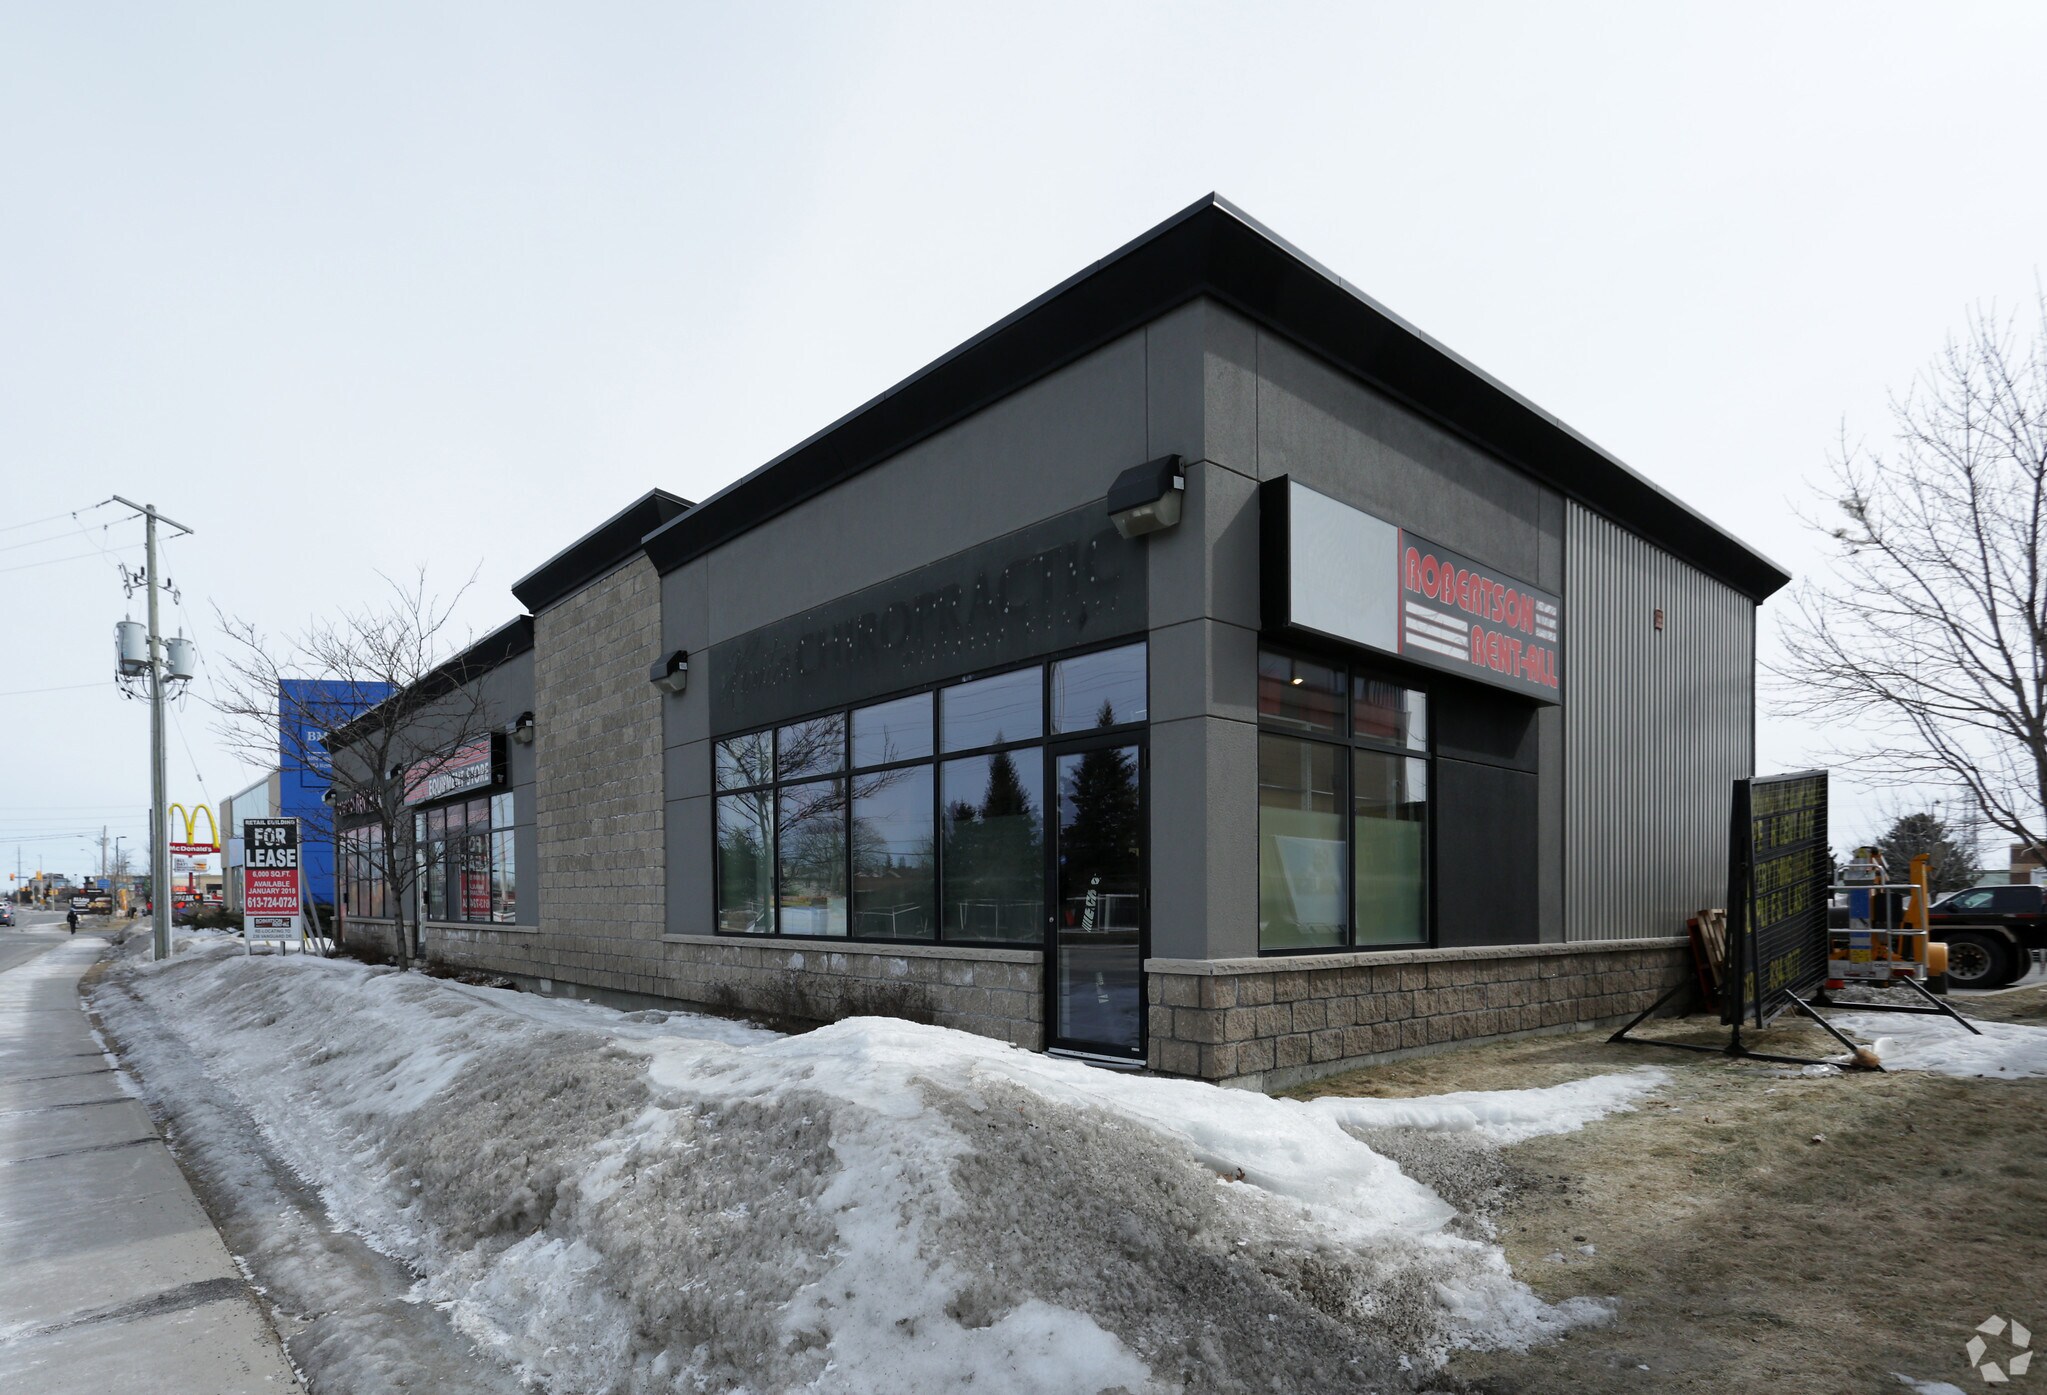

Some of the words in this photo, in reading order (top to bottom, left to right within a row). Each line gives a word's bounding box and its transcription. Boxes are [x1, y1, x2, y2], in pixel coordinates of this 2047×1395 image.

[1405, 546, 1535, 635] ROBERTSON
[1471, 625, 1557, 689] RENT-ALL
[429, 770, 464, 797] EQUIPMENT
[466, 762, 489, 786] STORE
[254, 828, 286, 846] FOR
[246, 849, 296, 868] LEASE
[247, 897, 297, 908] 613-724-0724
